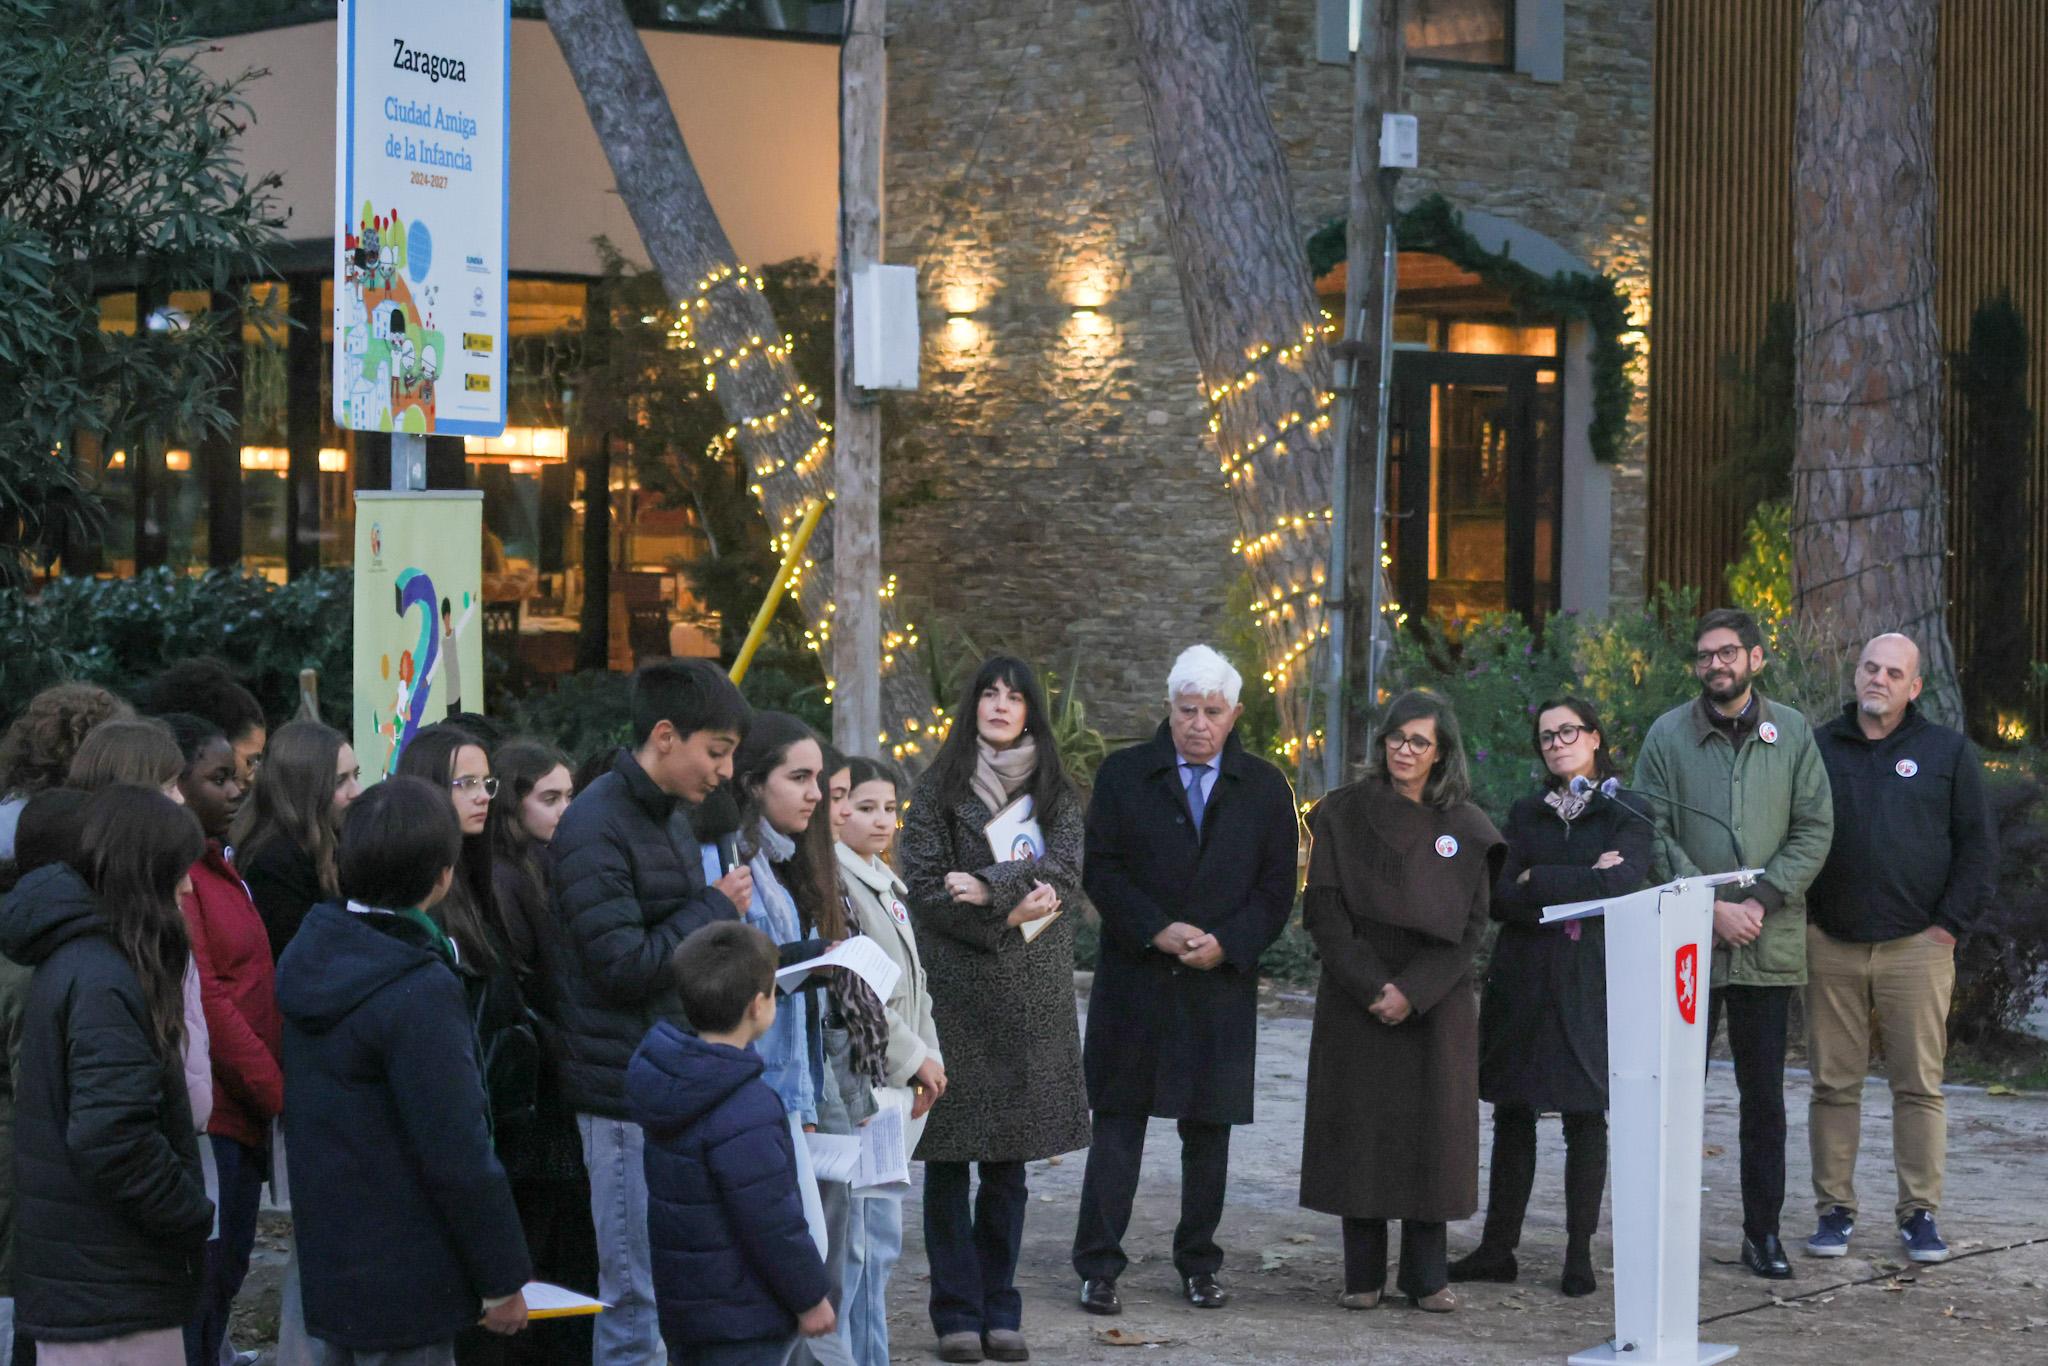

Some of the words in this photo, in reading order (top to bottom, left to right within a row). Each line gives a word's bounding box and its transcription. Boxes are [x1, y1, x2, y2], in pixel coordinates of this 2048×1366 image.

[393, 38, 466, 83] Zaragoza
[384, 96, 431, 127] Ciudad
[435, 107, 477, 139] Amiga
[385, 134, 402, 158] de
[405, 136, 416, 162] la
[419, 140, 472, 171] Infancia
[410, 171, 448, 189] 2024-2027
